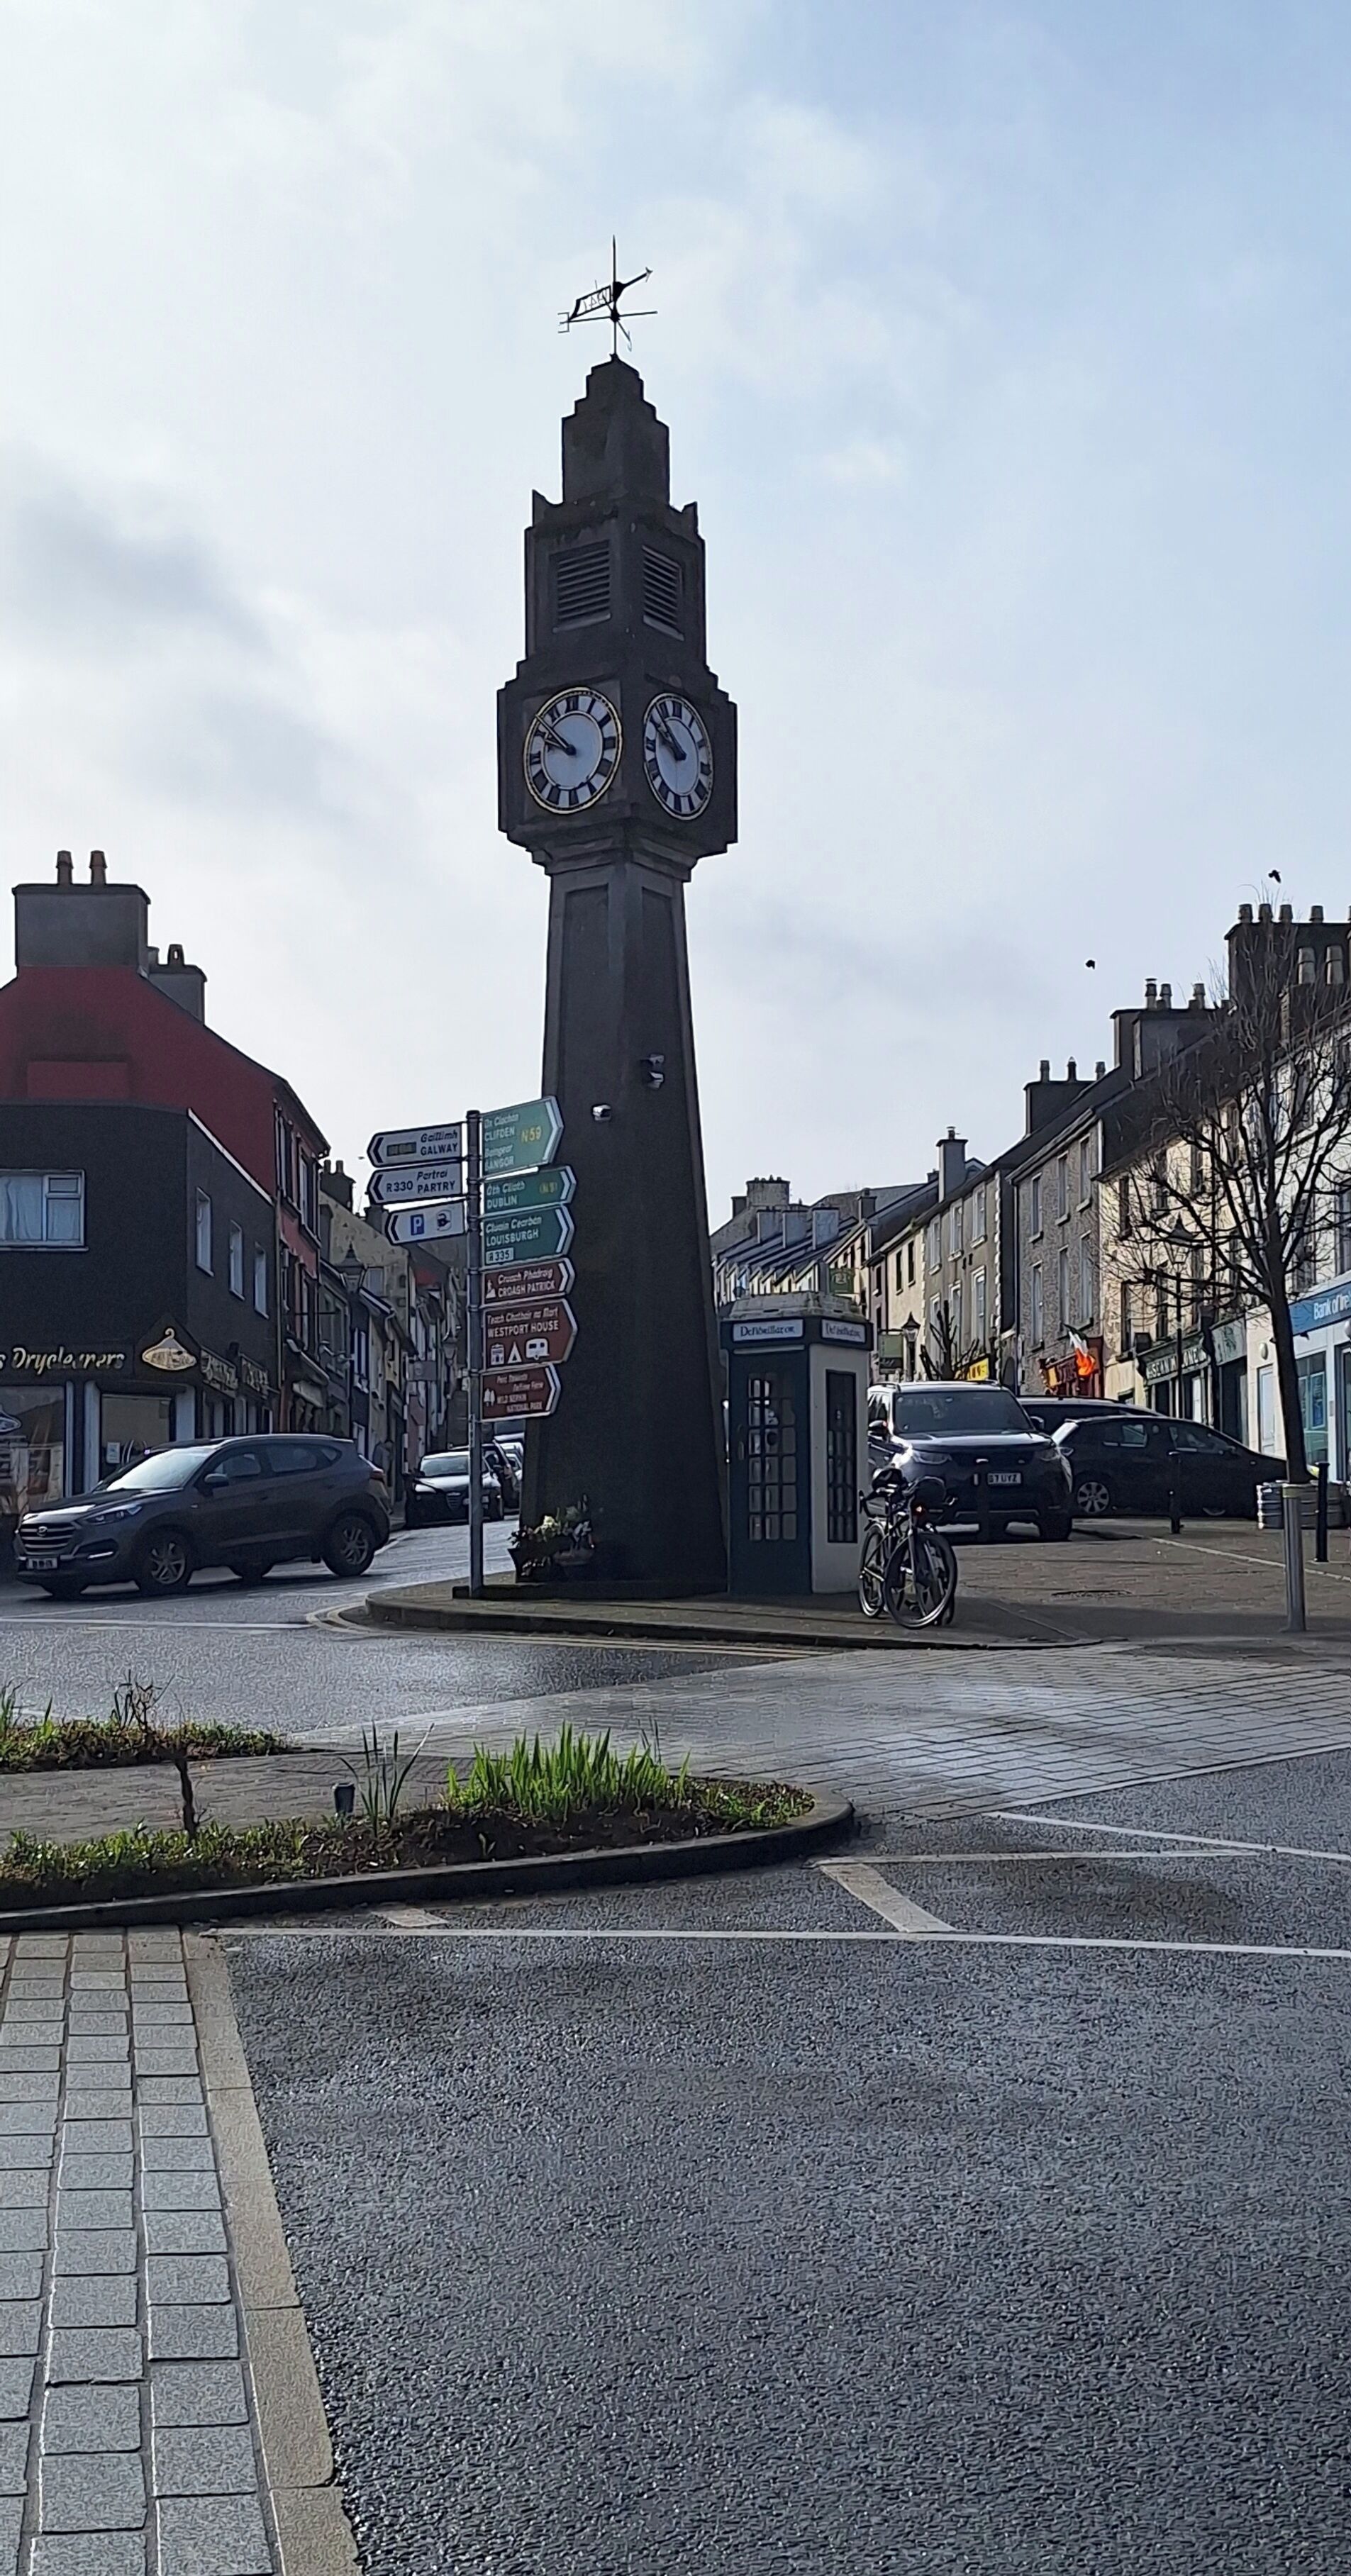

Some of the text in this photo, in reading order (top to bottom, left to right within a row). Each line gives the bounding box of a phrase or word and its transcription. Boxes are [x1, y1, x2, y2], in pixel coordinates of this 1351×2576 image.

[421, 1131, 458, 1144] Gaillimh
[484, 1126, 516, 1142] CLIFDEN
[521, 1126, 542, 1143] N59
[421, 1142, 458, 1156] GALWAY
[485, 1156, 515, 1171] BANGOR
[386, 1183, 413, 1193] R330
[417, 1180, 455, 1193] PARTRY
[487, 1195, 518, 1209] DUBLIN
[486, 1228, 539, 1247] LOUISBURGH
[498, 1280, 556, 1298] CROAGH PATRICK
[1313, 1298, 1331, 1320] Bank
[1332, 1294, 1340, 1313] of
[487, 1320, 560, 1338] WESTPORT HOUSE
